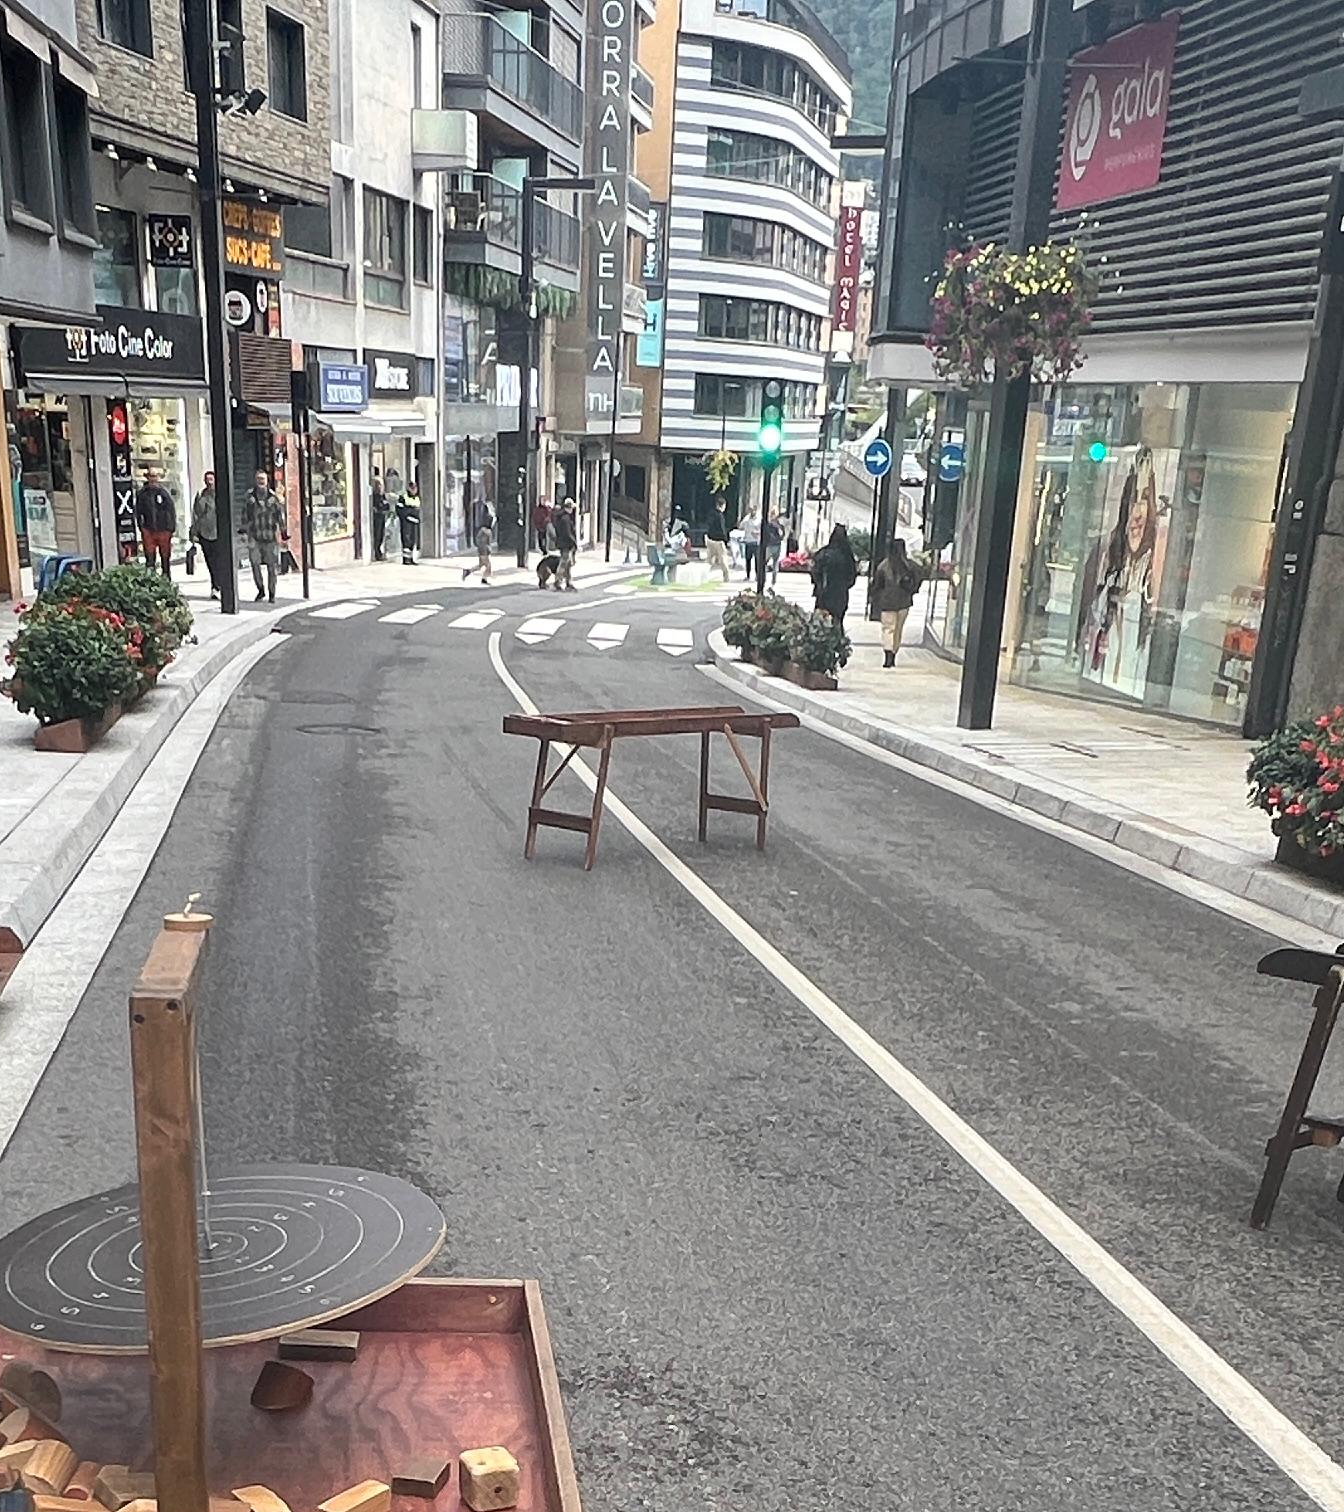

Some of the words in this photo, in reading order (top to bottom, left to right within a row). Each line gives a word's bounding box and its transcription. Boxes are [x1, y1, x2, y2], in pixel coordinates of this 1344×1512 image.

[1108, 56, 1166, 140] gala
[596, 146, 619, 207] LA
[591, 219, 617, 373] VELLA
[118, 324, 144, 358] Cine
